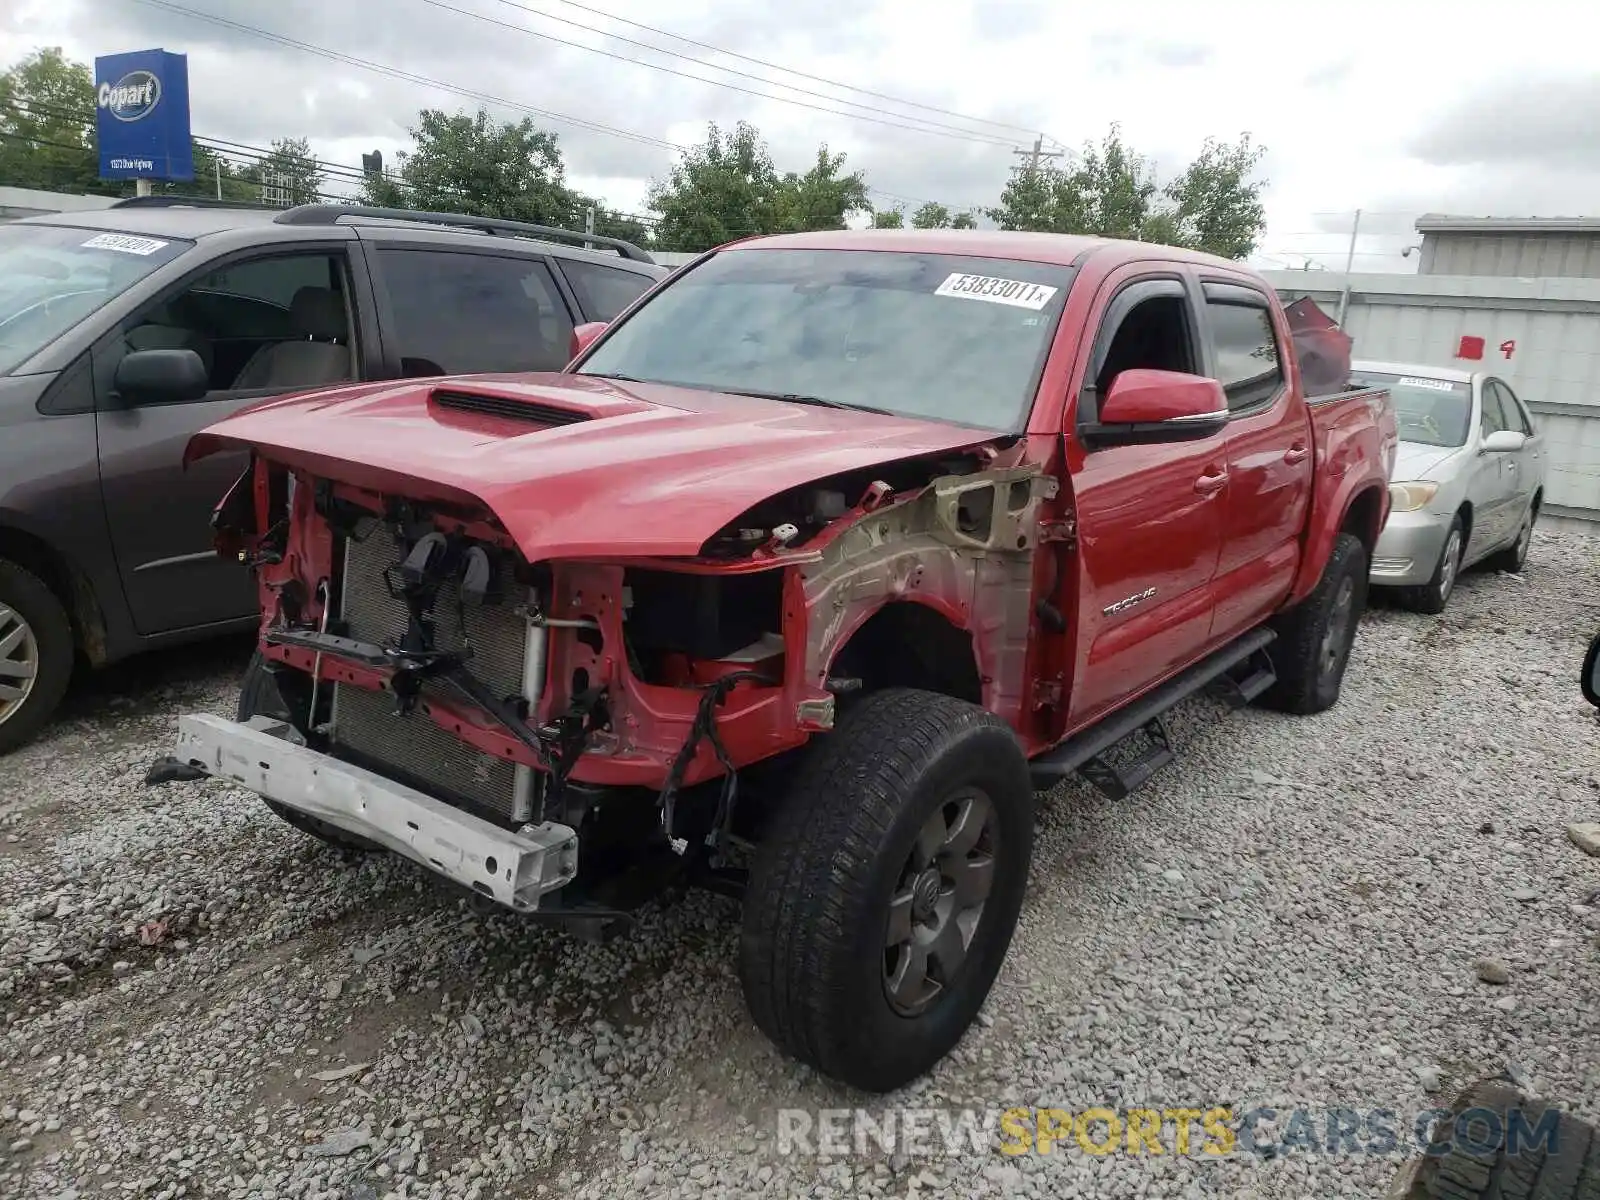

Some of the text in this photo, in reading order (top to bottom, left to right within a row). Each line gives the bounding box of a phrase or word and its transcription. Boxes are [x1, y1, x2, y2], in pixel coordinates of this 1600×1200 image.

[98, 78, 154, 113] Copart
[952, 275, 1040, 301] 53833011
[1499, 340, 1516, 360] 4
